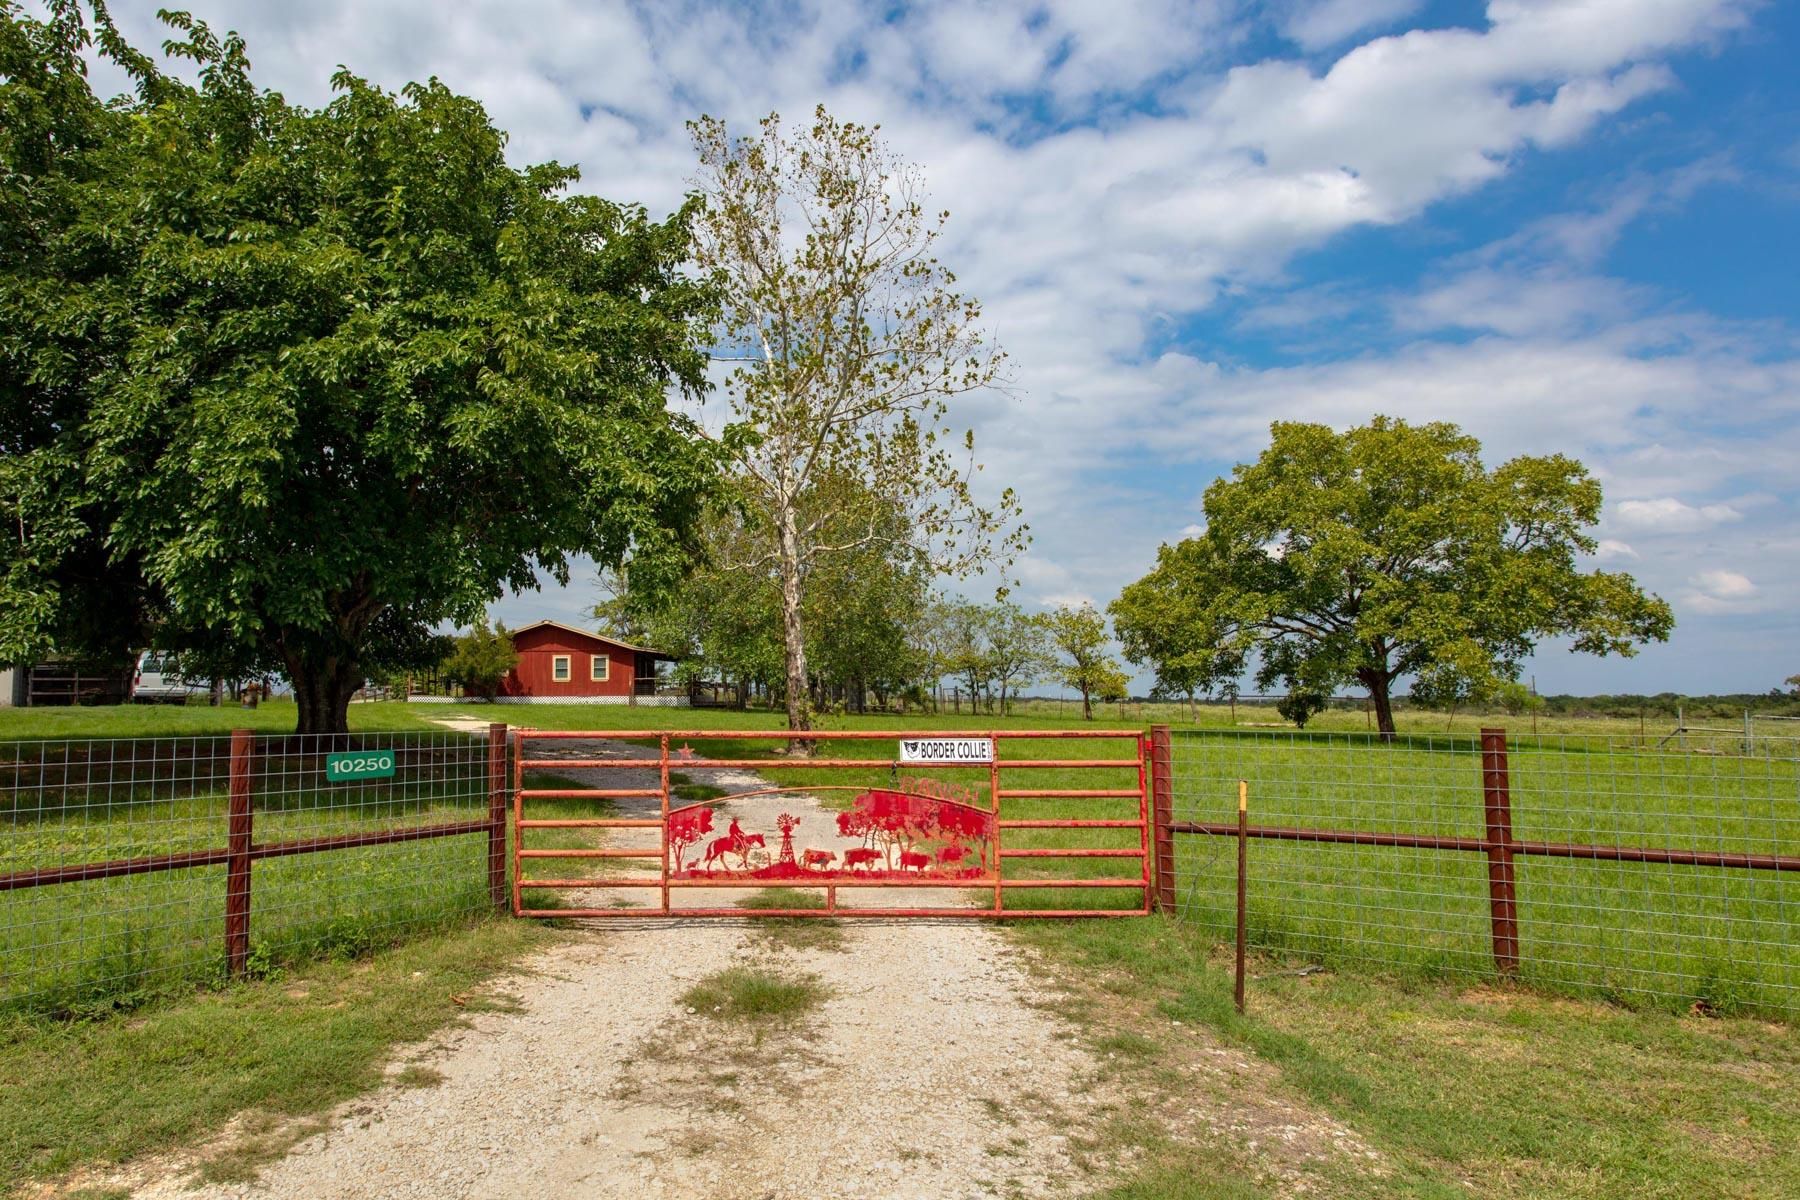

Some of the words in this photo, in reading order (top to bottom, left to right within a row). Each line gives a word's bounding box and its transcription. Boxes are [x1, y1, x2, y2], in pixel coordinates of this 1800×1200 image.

[921, 742, 955, 758] BORDER
[957, 742, 986, 758] COLLIE
[330, 757, 391, 773] 10250
[900, 776, 979, 806] RANCH
